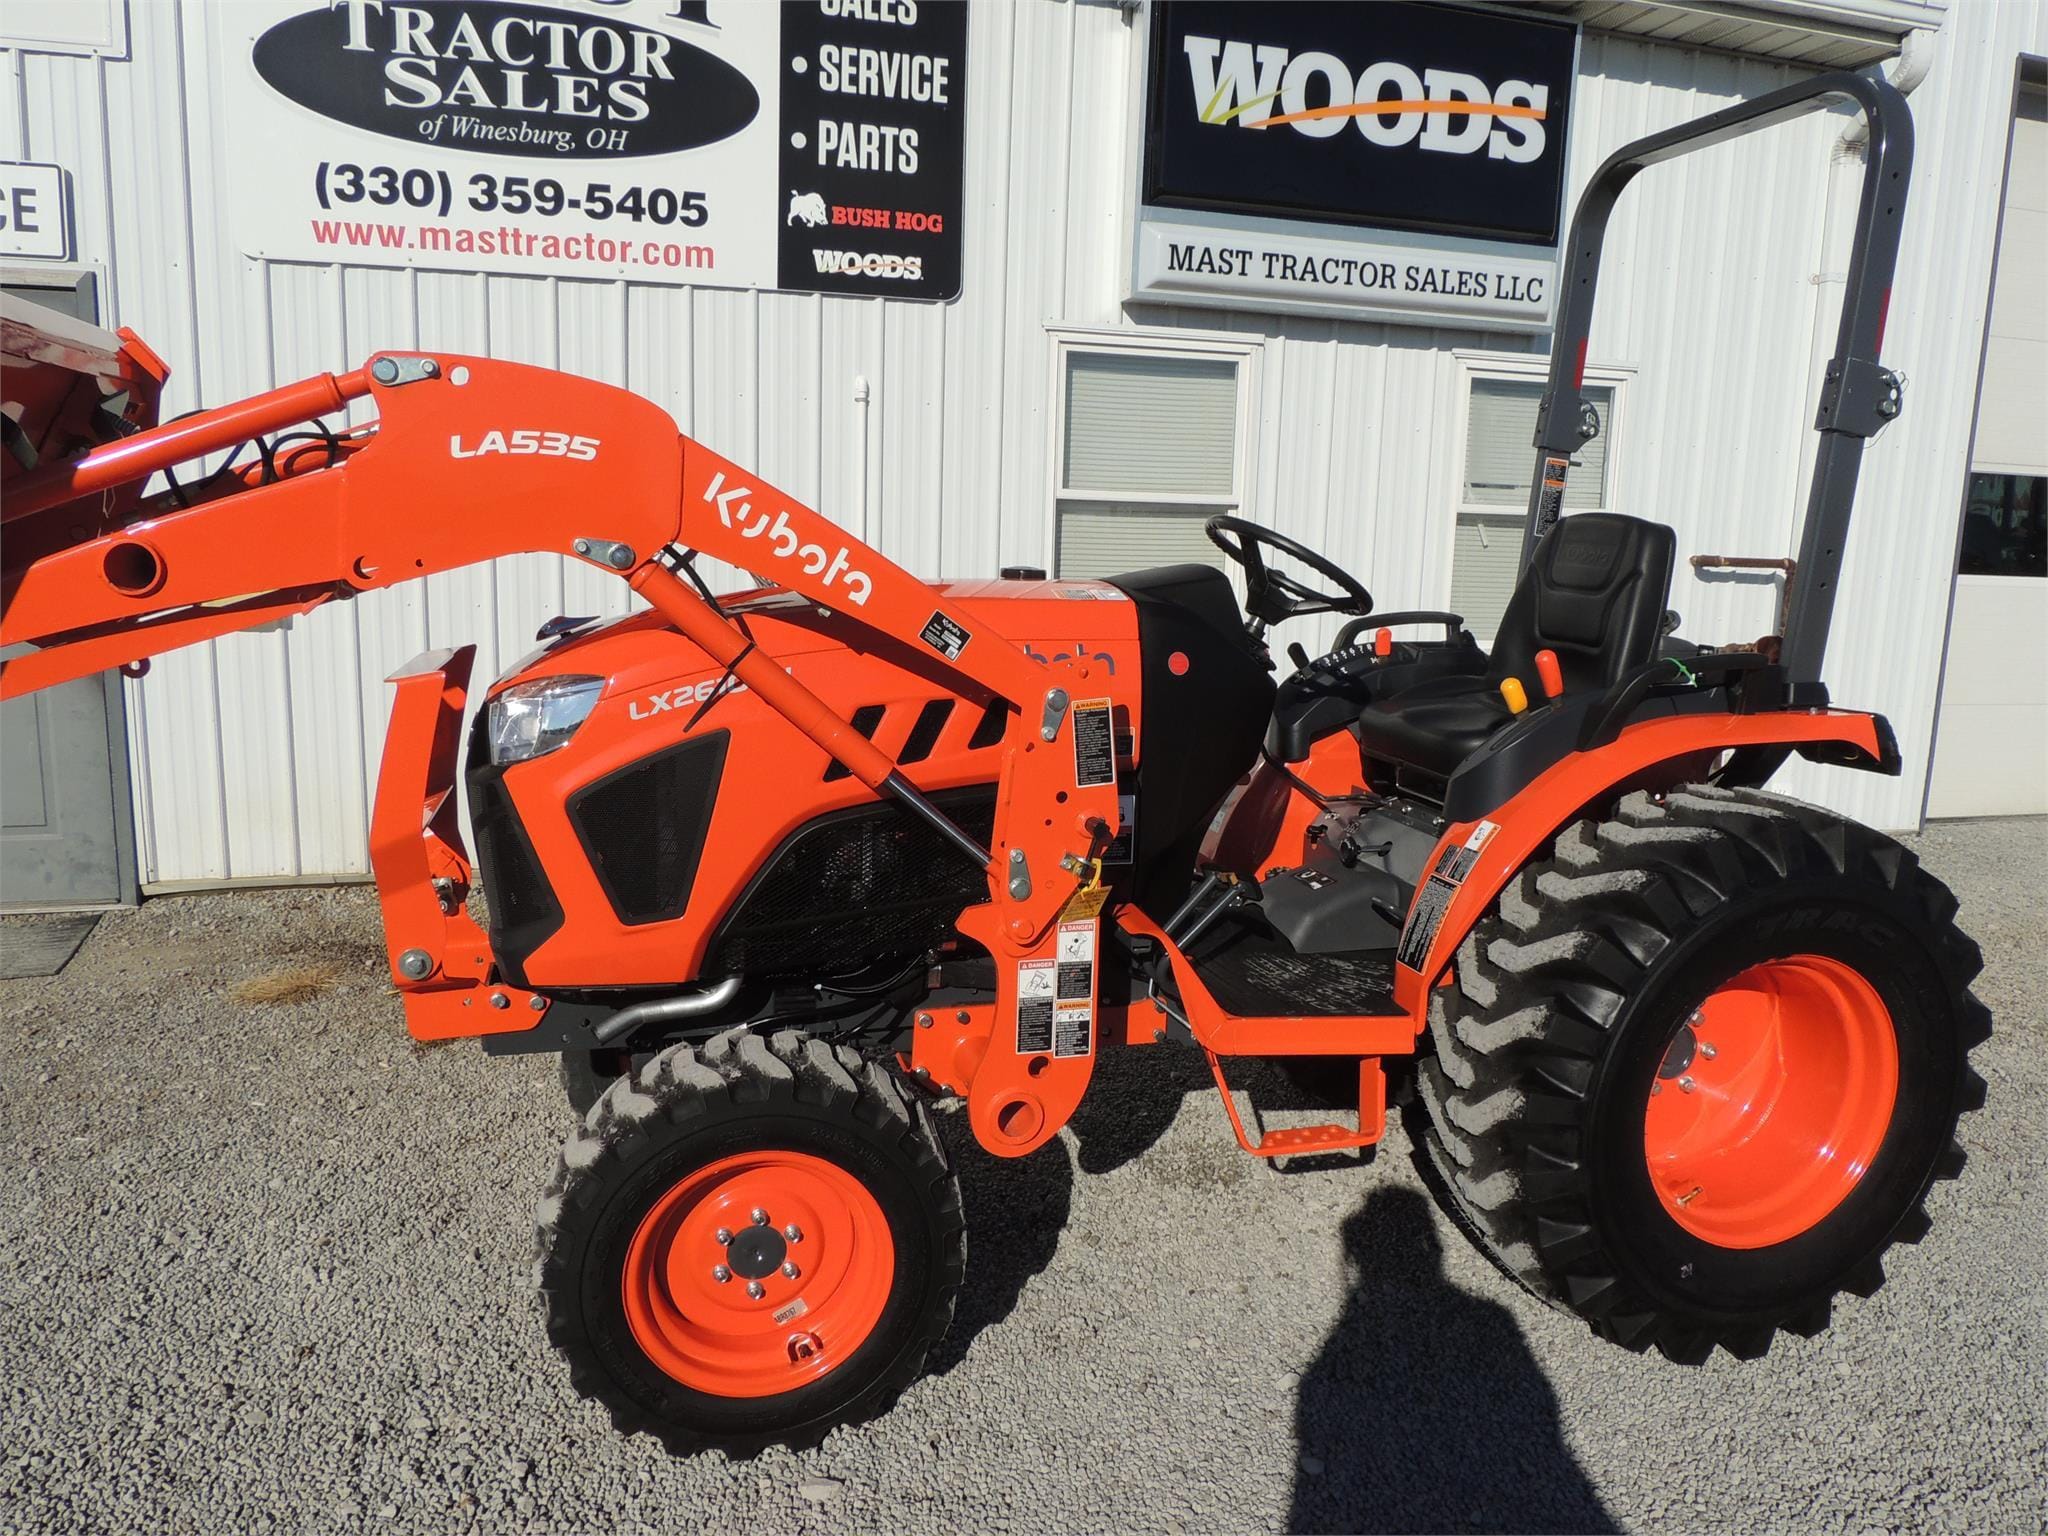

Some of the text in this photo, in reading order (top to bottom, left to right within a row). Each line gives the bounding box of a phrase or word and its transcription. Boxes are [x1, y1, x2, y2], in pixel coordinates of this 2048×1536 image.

[331, 0, 676, 80] TRACTOR
[384, 57, 651, 122] SALES
[819, 44, 949, 104] SERVICE
[1184, 35, 1549, 164] WOODS
[419, 114, 629, 152] of Winesburg, OH
[818, 119, 919, 175] PARTS
[315, 161, 710, 228] (330) 359-5405
[832, 206, 943, 233] BUSH HOG
[311, 219, 716, 269] www.masttractor.com
[812, 249, 923, 281] WOODS
[1167, 243, 1544, 303] MAST TRACTOR SALES LLC
[450, 429, 601, 462] LA535
[703, 472, 873, 606] Kubota
